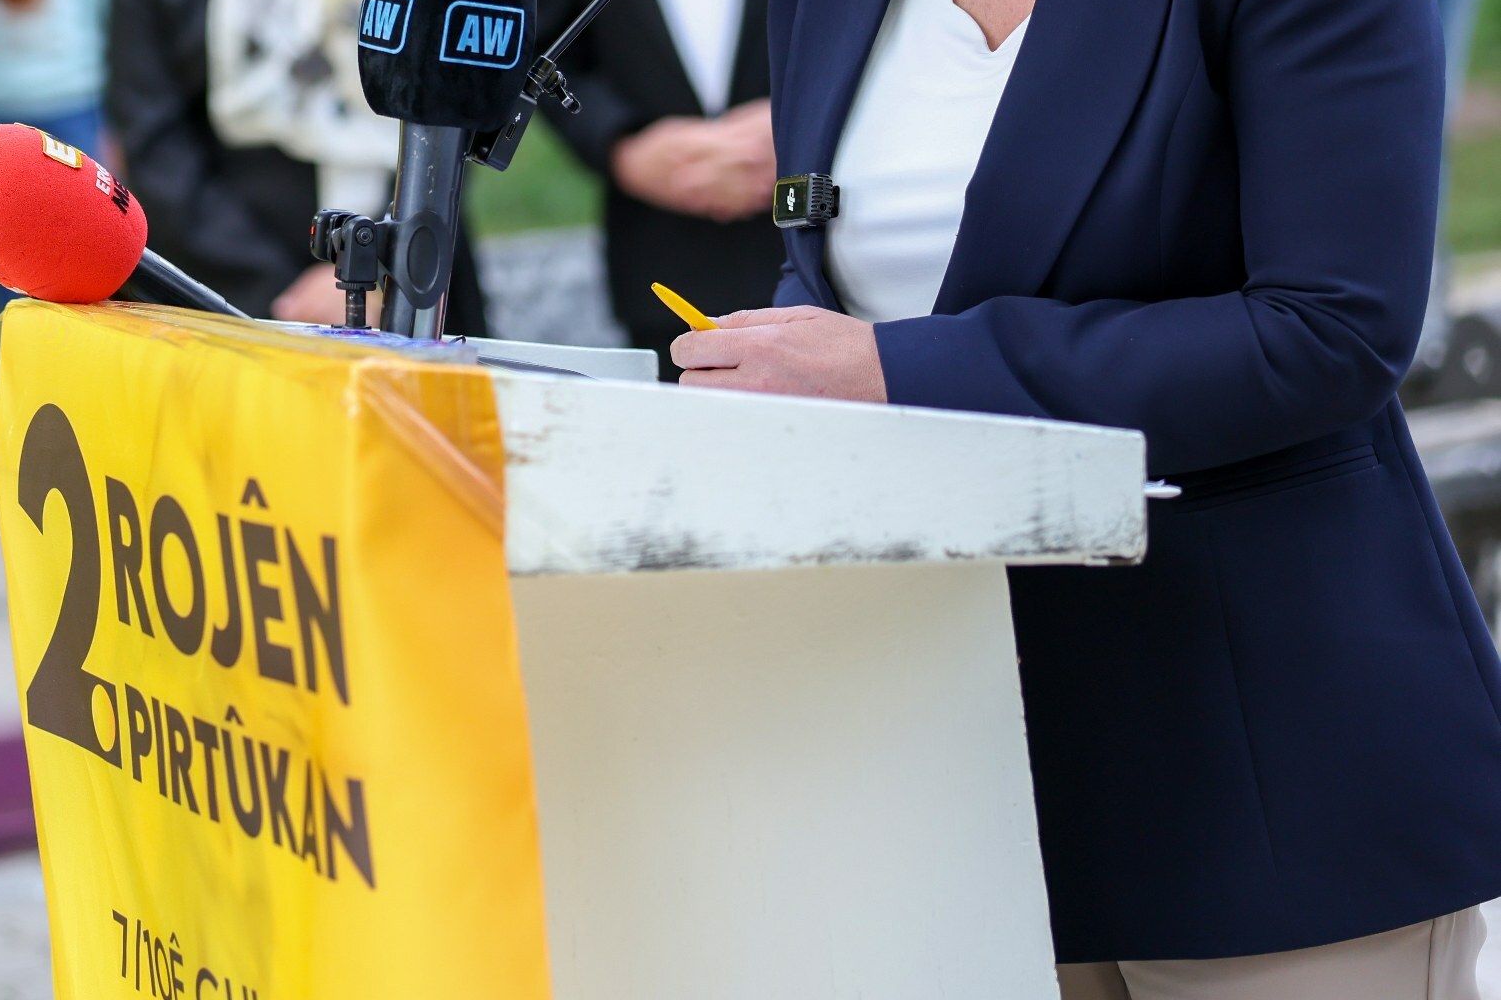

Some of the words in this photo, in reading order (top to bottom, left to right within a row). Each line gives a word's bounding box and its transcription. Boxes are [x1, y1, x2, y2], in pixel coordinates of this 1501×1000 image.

[456, 14, 514, 57] AW
[105, 475, 350, 707] ROJÊN
[125, 683, 376, 891] PIRTÛKAN
